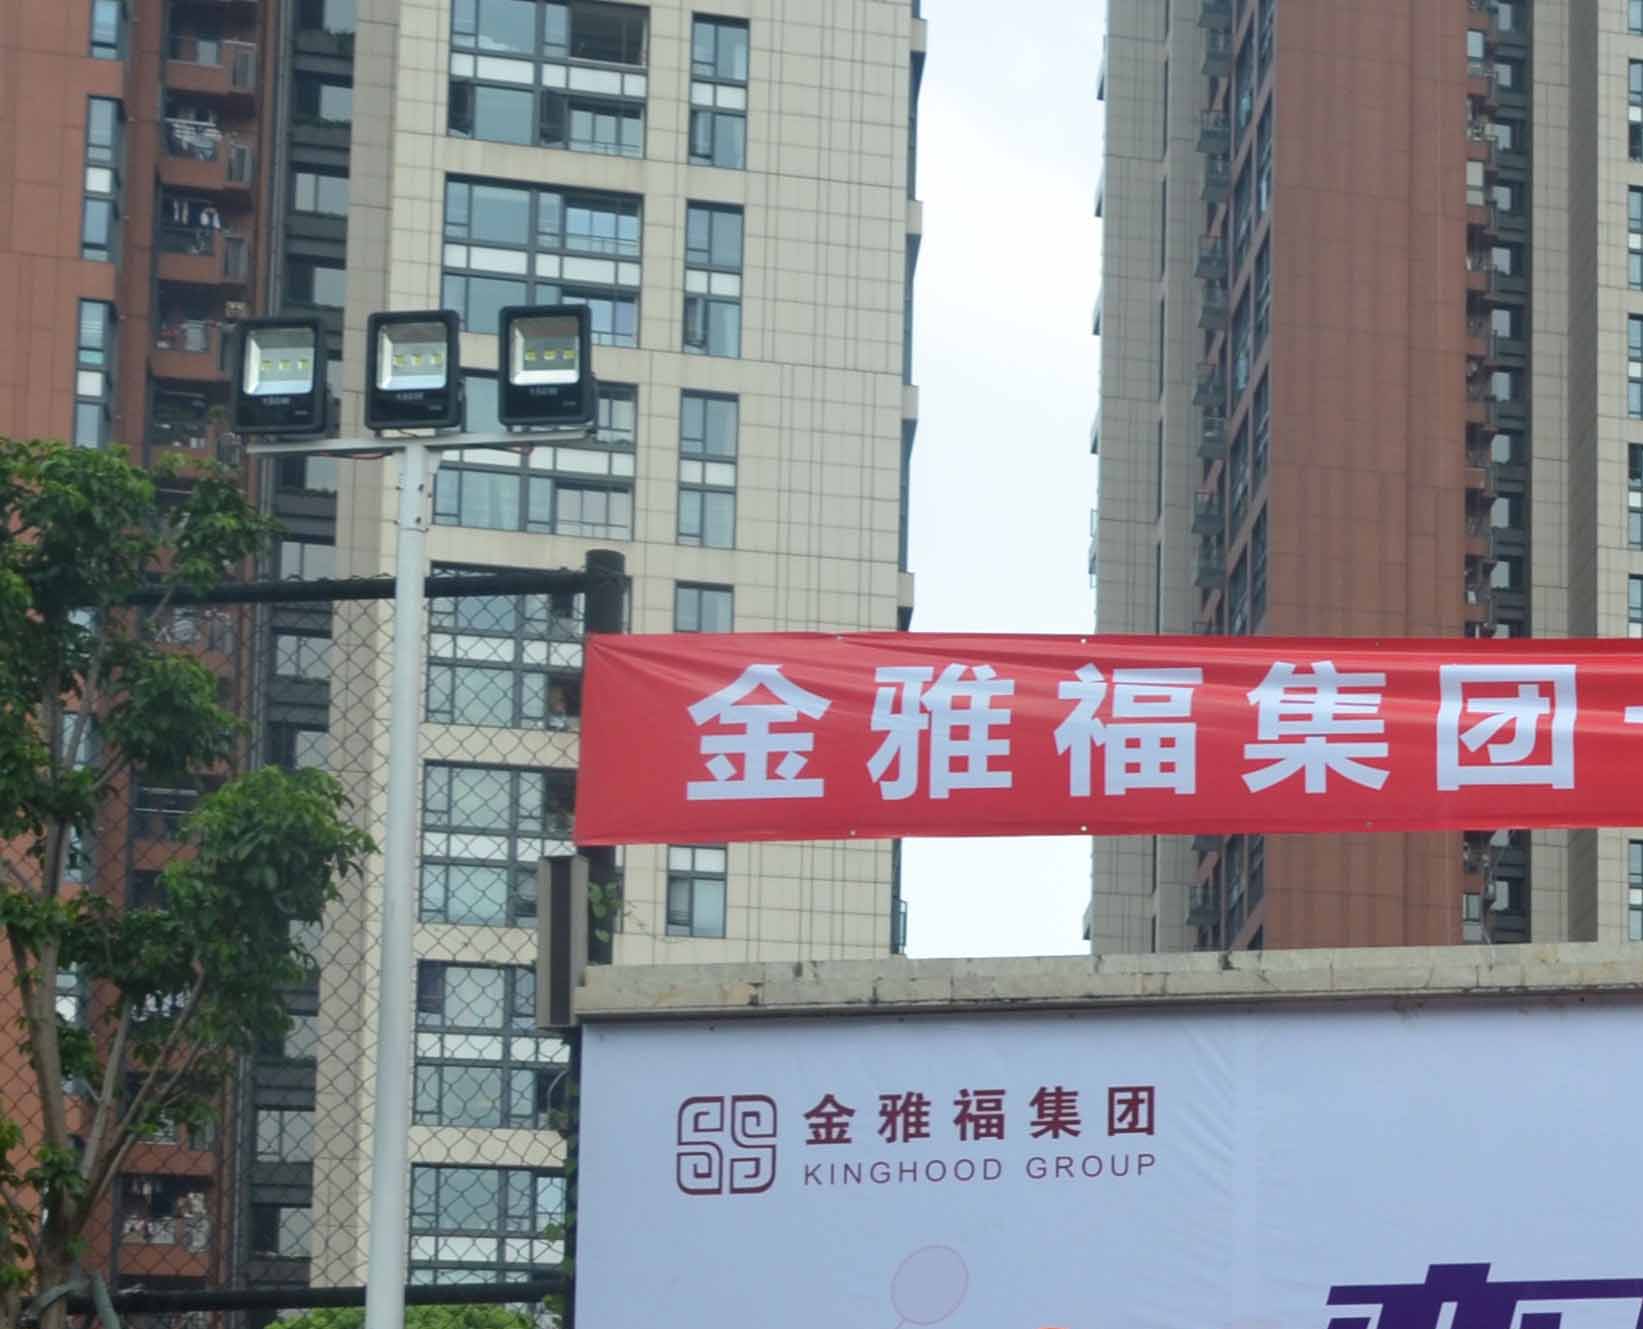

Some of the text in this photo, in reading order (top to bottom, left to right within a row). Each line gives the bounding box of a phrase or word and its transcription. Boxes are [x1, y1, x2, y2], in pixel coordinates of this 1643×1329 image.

[802, 1085, 1156, 1146] 金雅福集团
[804, 1152, 1156, 1186] KINGHOOD GROUP
